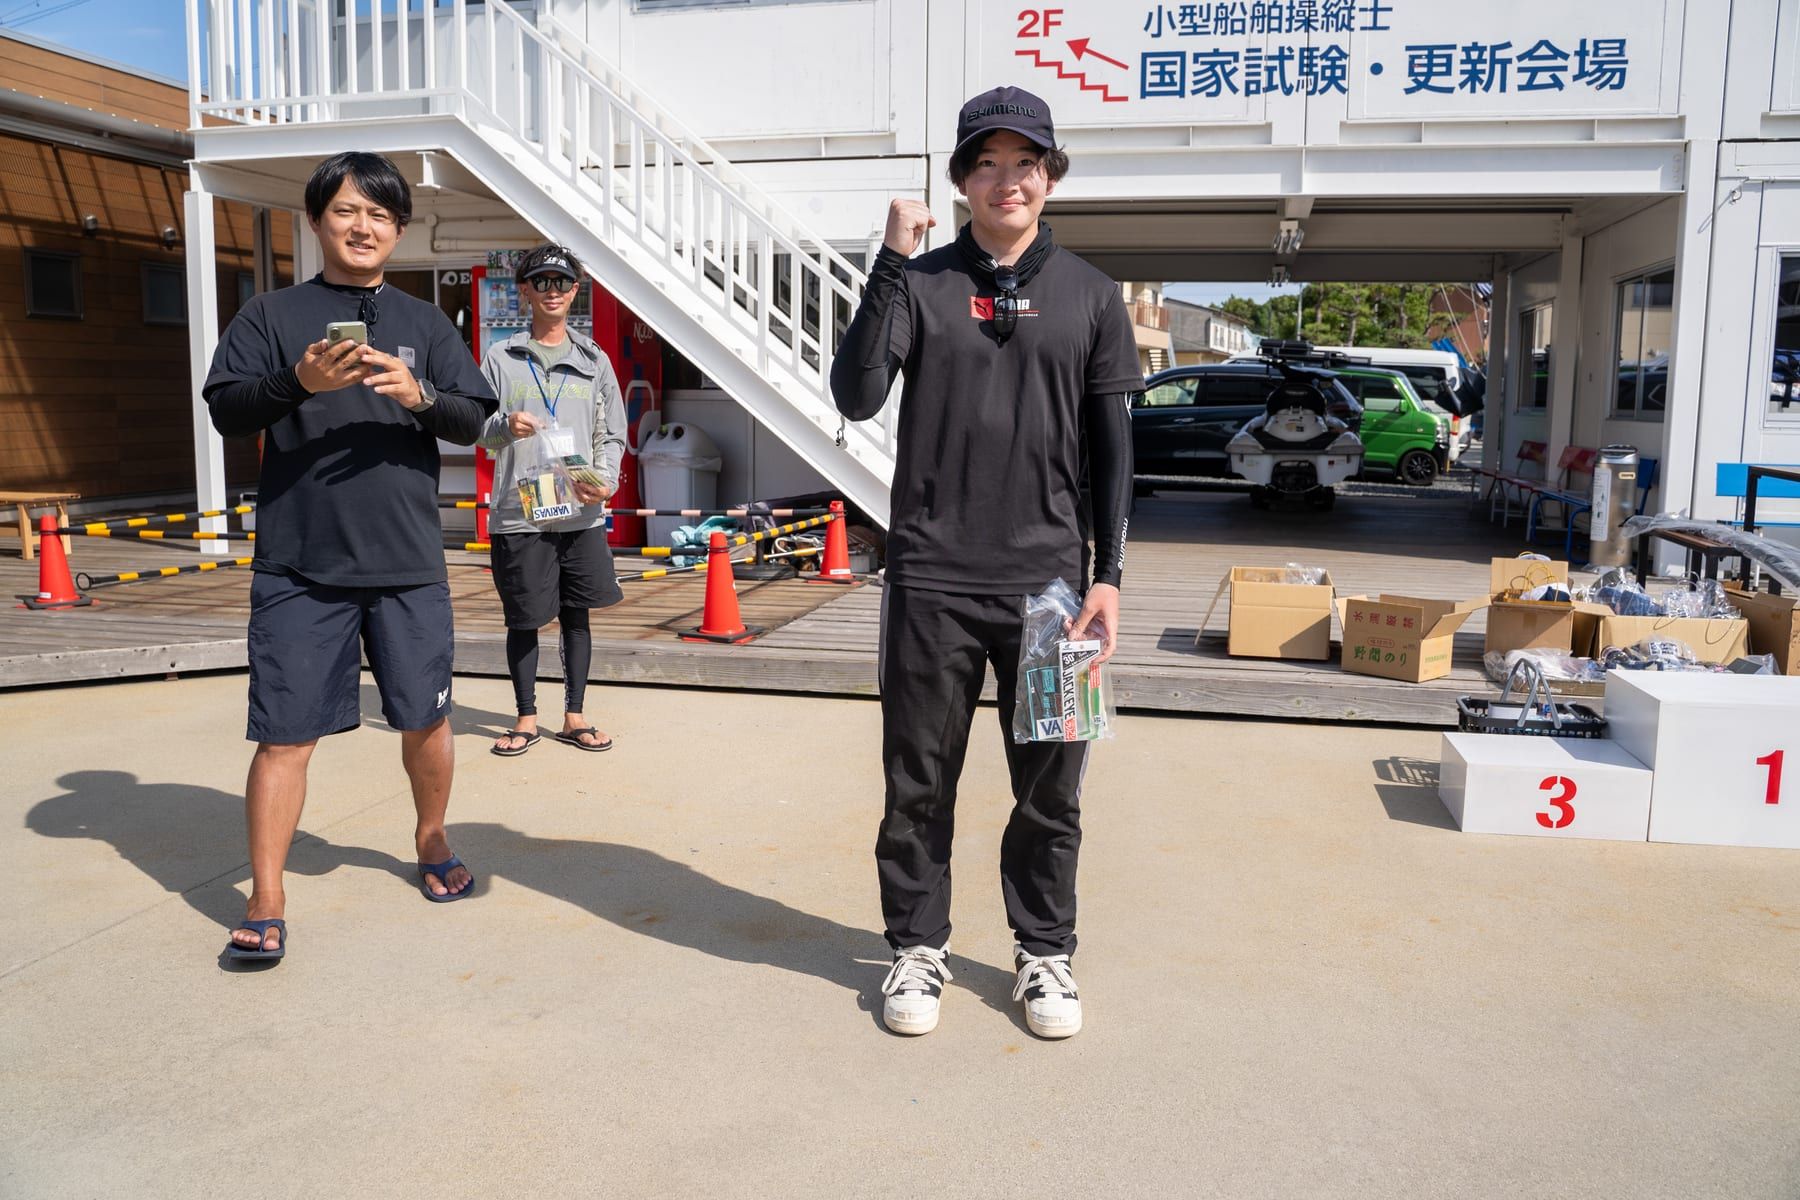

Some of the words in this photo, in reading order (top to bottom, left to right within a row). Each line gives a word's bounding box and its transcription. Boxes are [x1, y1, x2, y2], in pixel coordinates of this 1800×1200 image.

[1016, 9, 1064, 38] 2F
[1143, 0, 1394, 38] 小型船舶操縦士
[967, 103, 1038, 122] SHIMANO
[459, 272, 472, 285] E
[534, 504, 570, 519] VARIVAS
[1117, 517, 1129, 570] mazume
[1756, 749, 1785, 804] 1
[1535, 775, 1578, 829] 3
